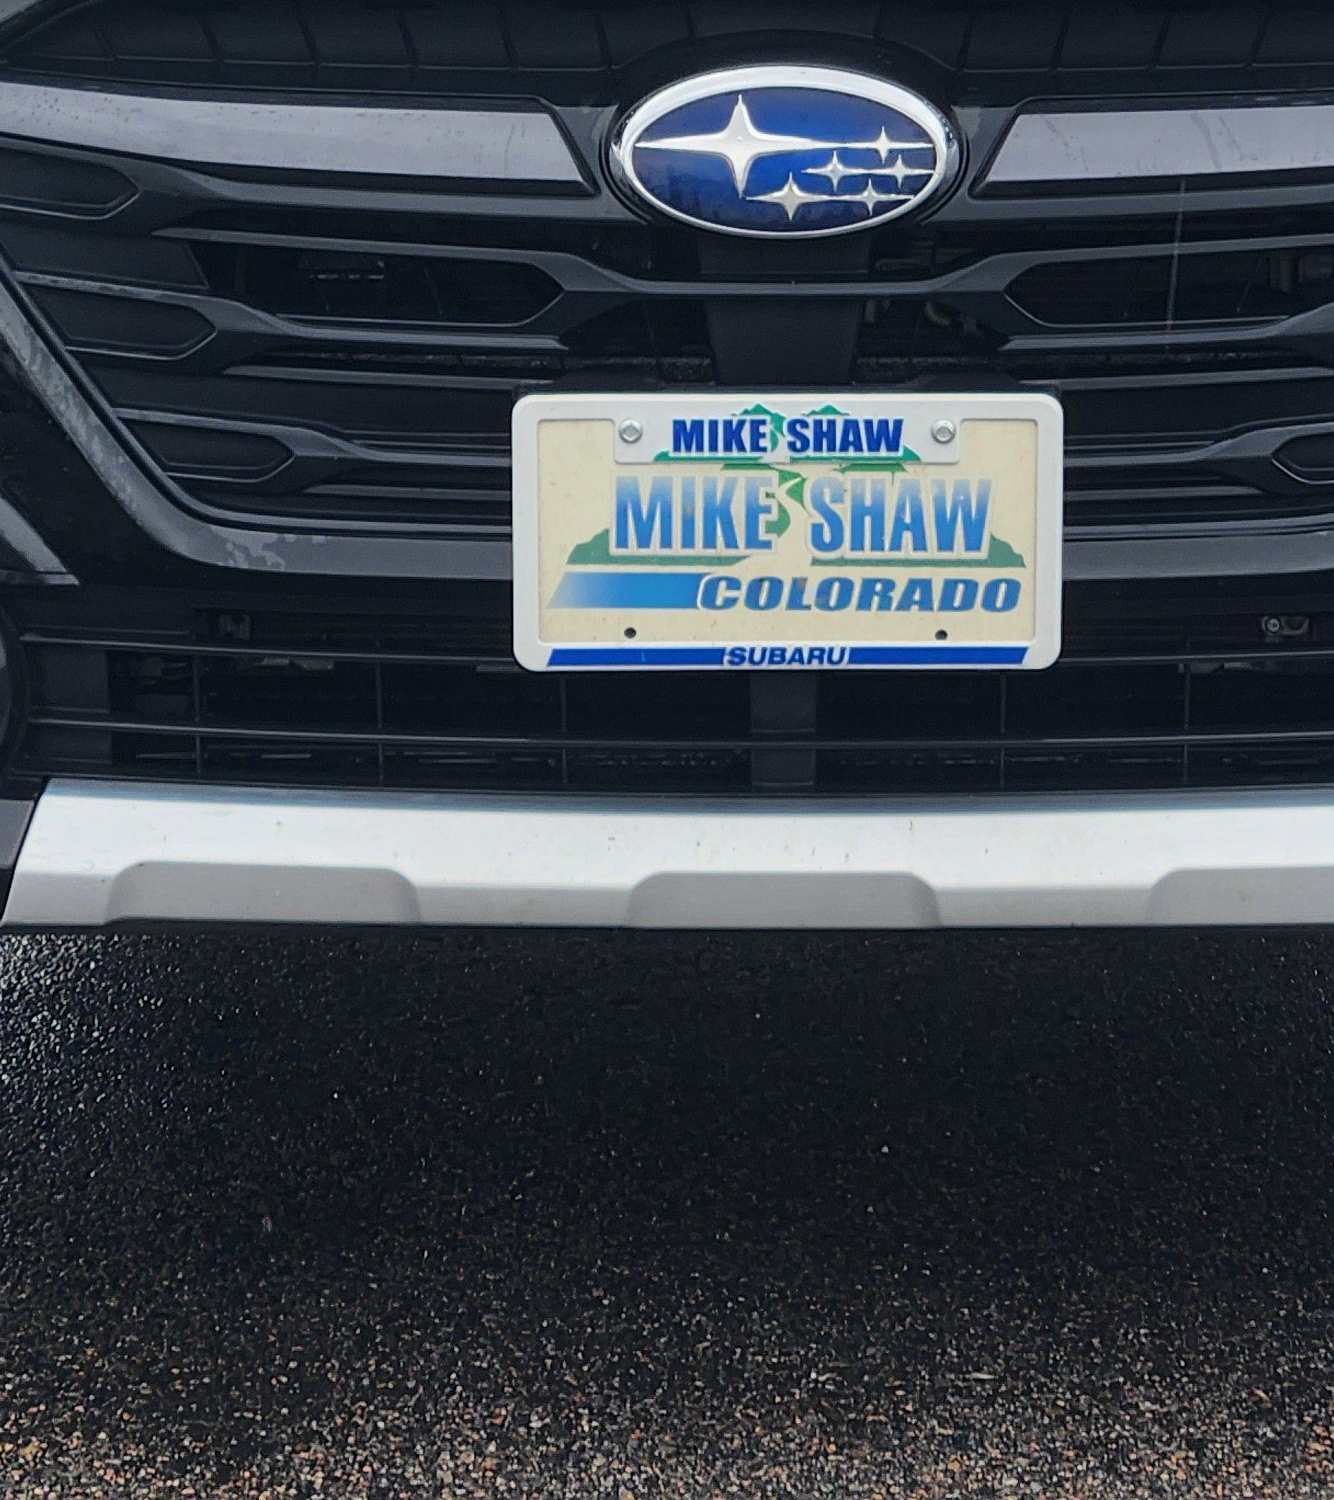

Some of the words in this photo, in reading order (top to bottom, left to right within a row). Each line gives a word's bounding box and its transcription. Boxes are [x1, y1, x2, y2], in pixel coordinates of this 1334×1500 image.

[671, 418, 768, 453] MIKE
[787, 418, 904, 454] SHAW
[613, 475, 774, 551] MIKE
[809, 476, 992, 555] SHAW
[699, 575, 1022, 612] COLORADO
[726, 647, 848, 667] SUBARU
